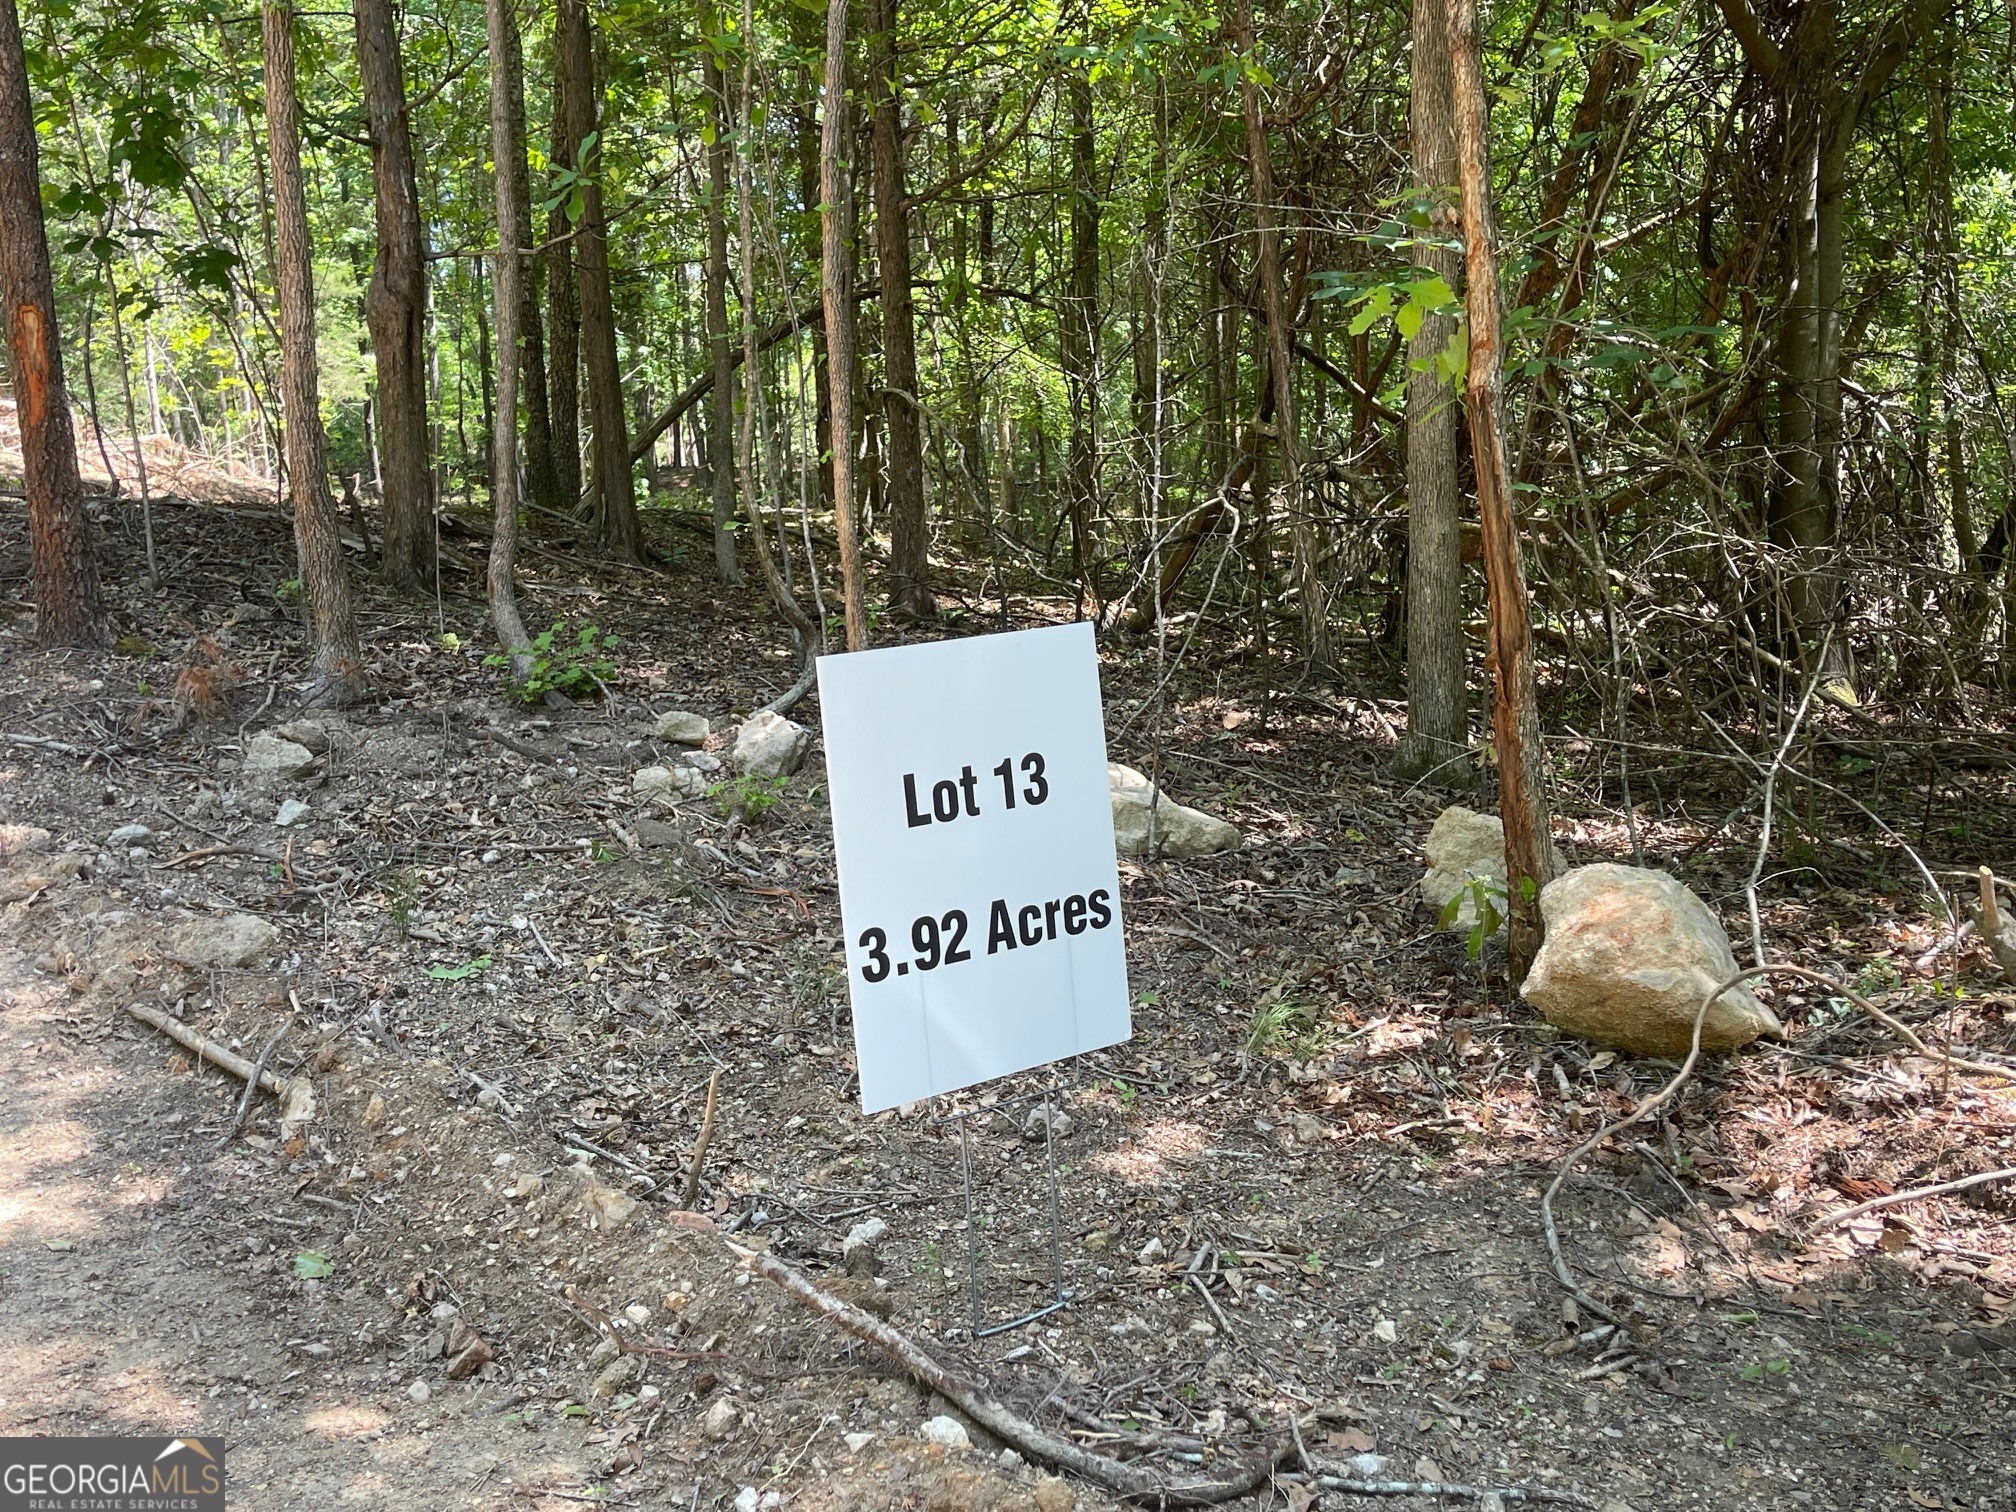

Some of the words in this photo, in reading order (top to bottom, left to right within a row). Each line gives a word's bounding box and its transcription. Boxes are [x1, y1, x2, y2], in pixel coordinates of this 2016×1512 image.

[903, 765, 981, 829] Lot
[993, 752, 1049, 810] 13
[858, 909, 971, 984] 3.92
[987, 888, 1112, 956] Acres
